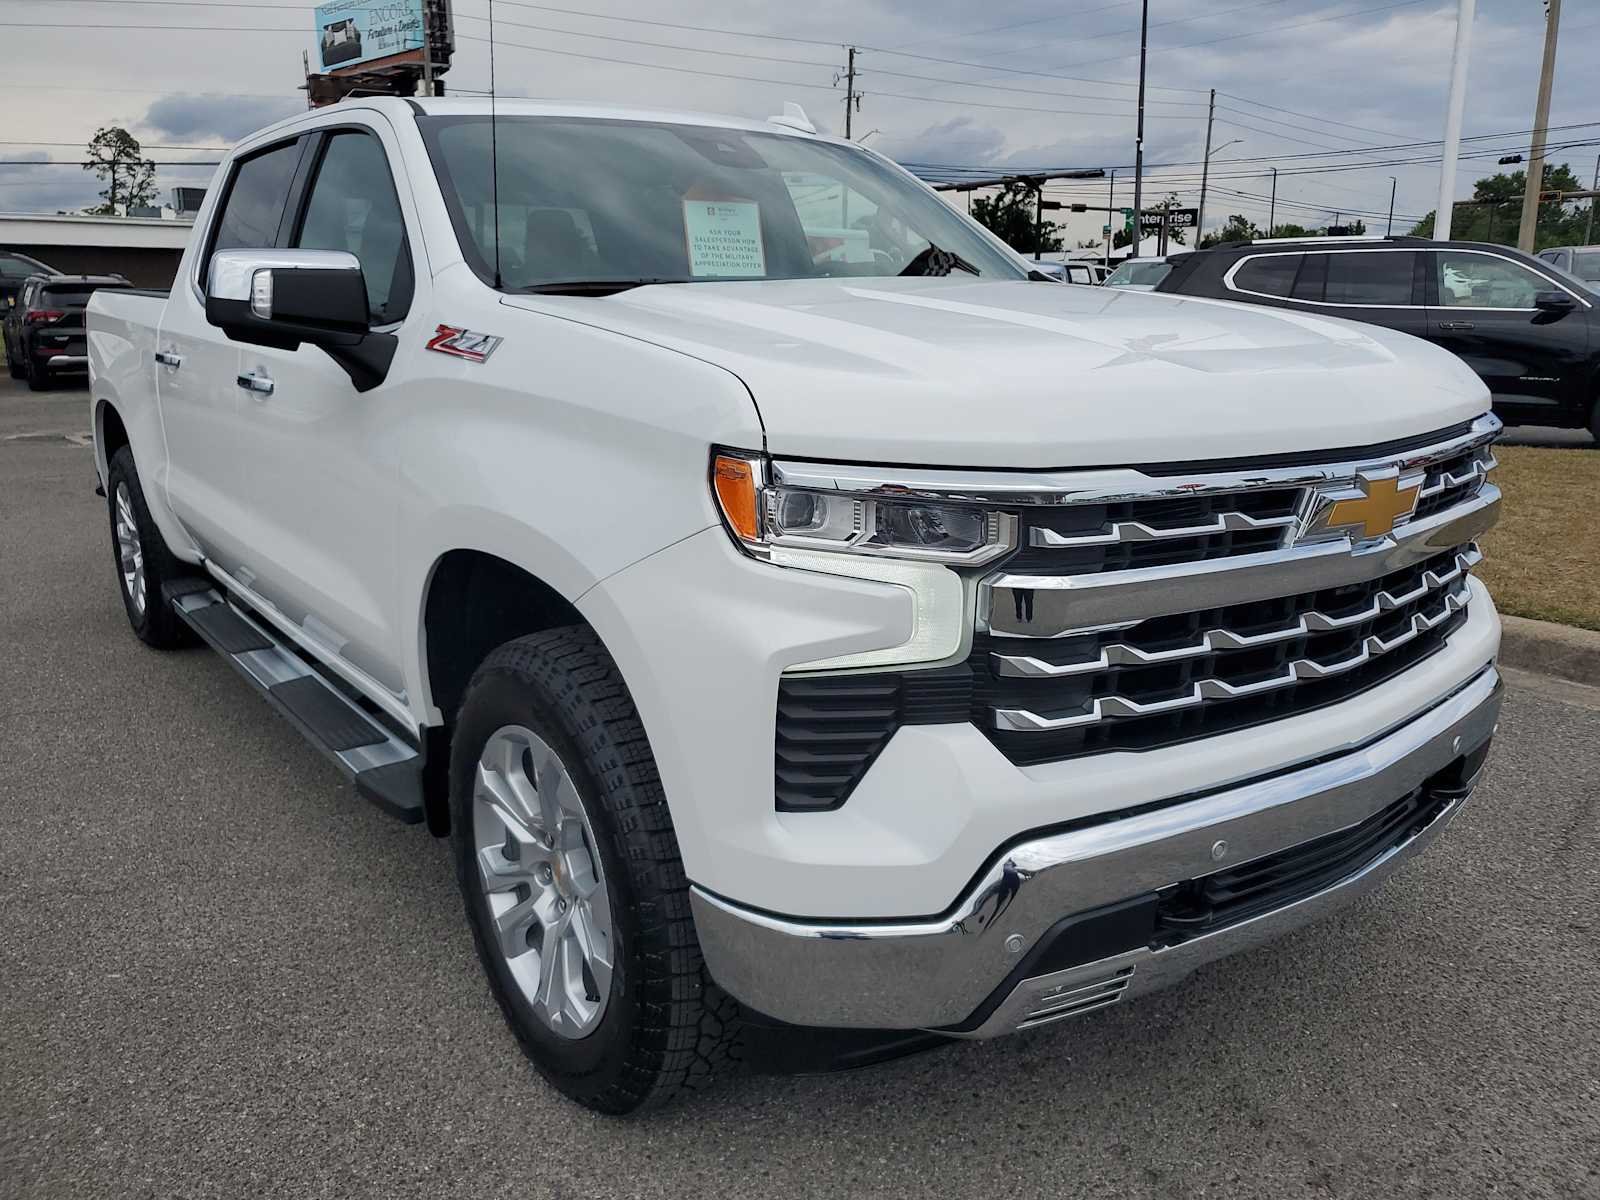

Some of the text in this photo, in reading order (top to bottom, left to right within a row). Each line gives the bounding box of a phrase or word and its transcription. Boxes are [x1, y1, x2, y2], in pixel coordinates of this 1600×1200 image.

[694, 236, 740, 244] SALESPERSON
[694, 260, 741, 268] APPRECIATION
[425, 323, 504, 364] Z71
